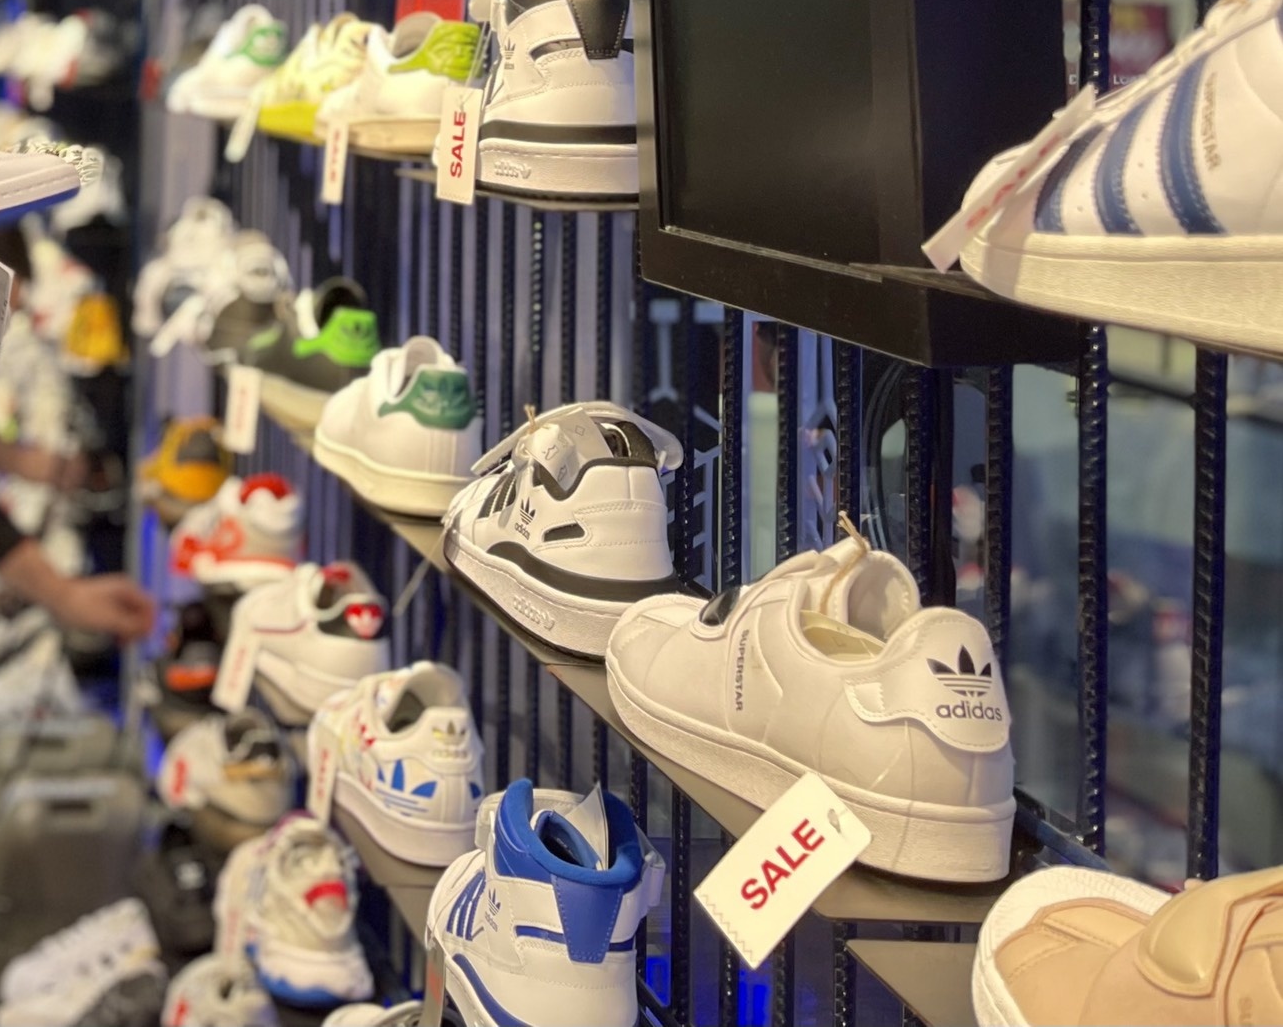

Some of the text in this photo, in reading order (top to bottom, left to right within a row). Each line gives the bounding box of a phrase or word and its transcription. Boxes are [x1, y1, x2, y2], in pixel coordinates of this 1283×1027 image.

[450, 111, 466, 178] SALE
[735, 628, 750, 711] SUPERSTAR
[935, 699, 1003, 722] adidas
[740, 818, 825, 910] SALE
